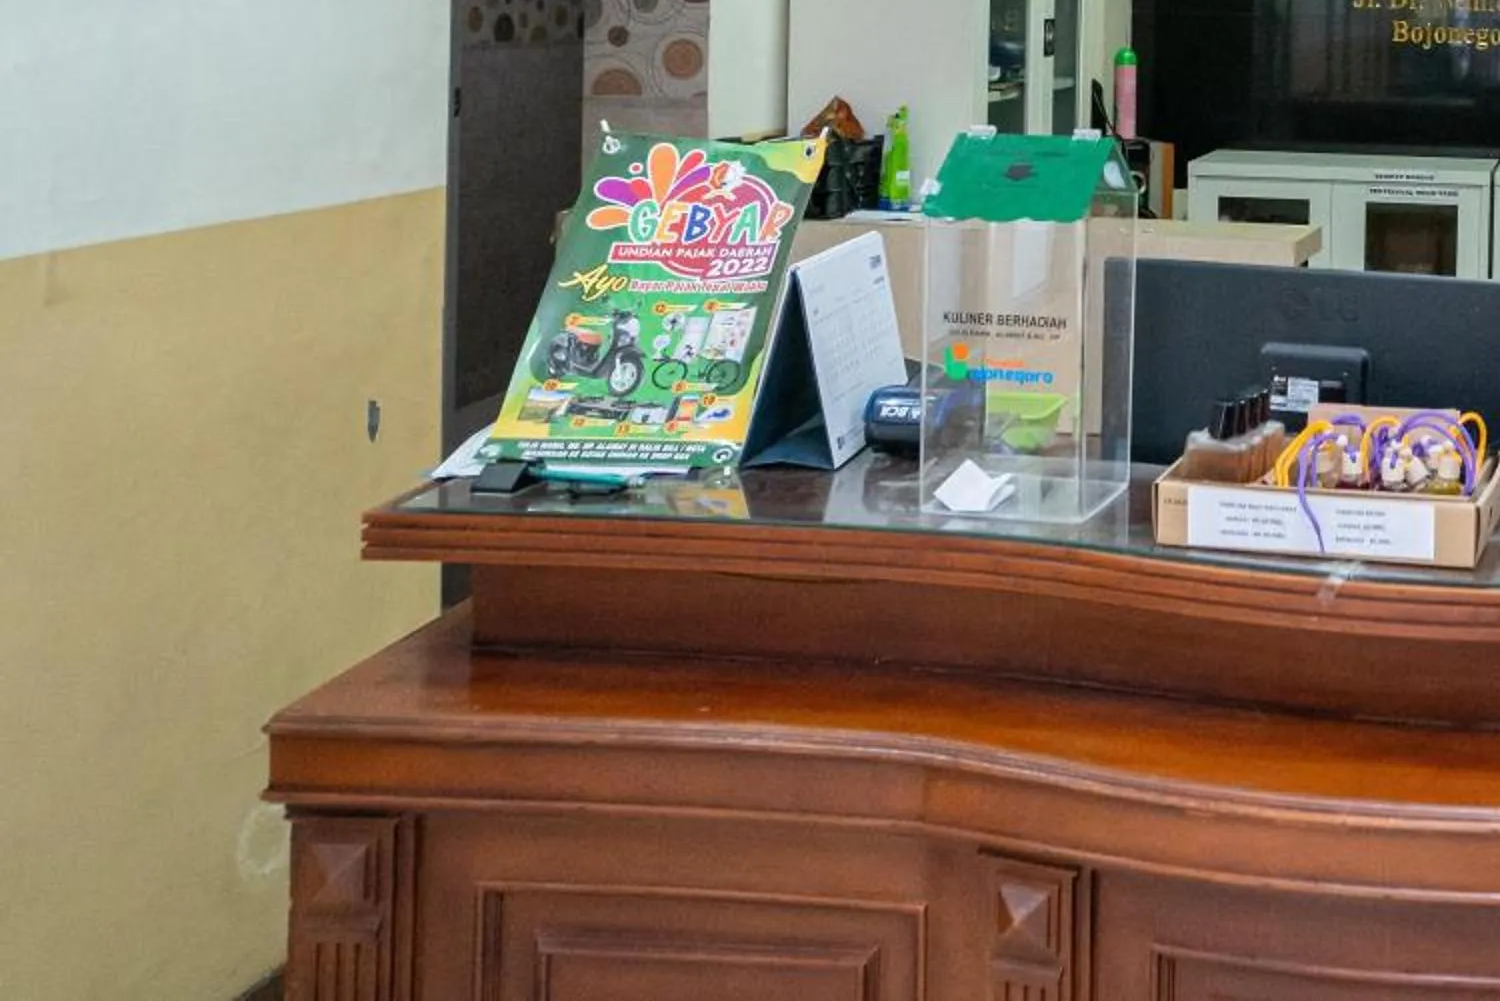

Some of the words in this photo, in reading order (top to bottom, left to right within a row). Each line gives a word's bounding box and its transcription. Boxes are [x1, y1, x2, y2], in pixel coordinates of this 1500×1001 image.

[628, 199, 794, 245] GEBYAR
[618, 246, 673, 258] UNDIAN
[676, 247, 715, 258] PAJAK
[719, 245, 772, 258] DAERAH
[707, 257, 768, 277] 2022
[558, 264, 629, 301] Ayo
[943, 312, 993, 326] KULINER
[997, 314, 1067, 329] BERHADIAH
